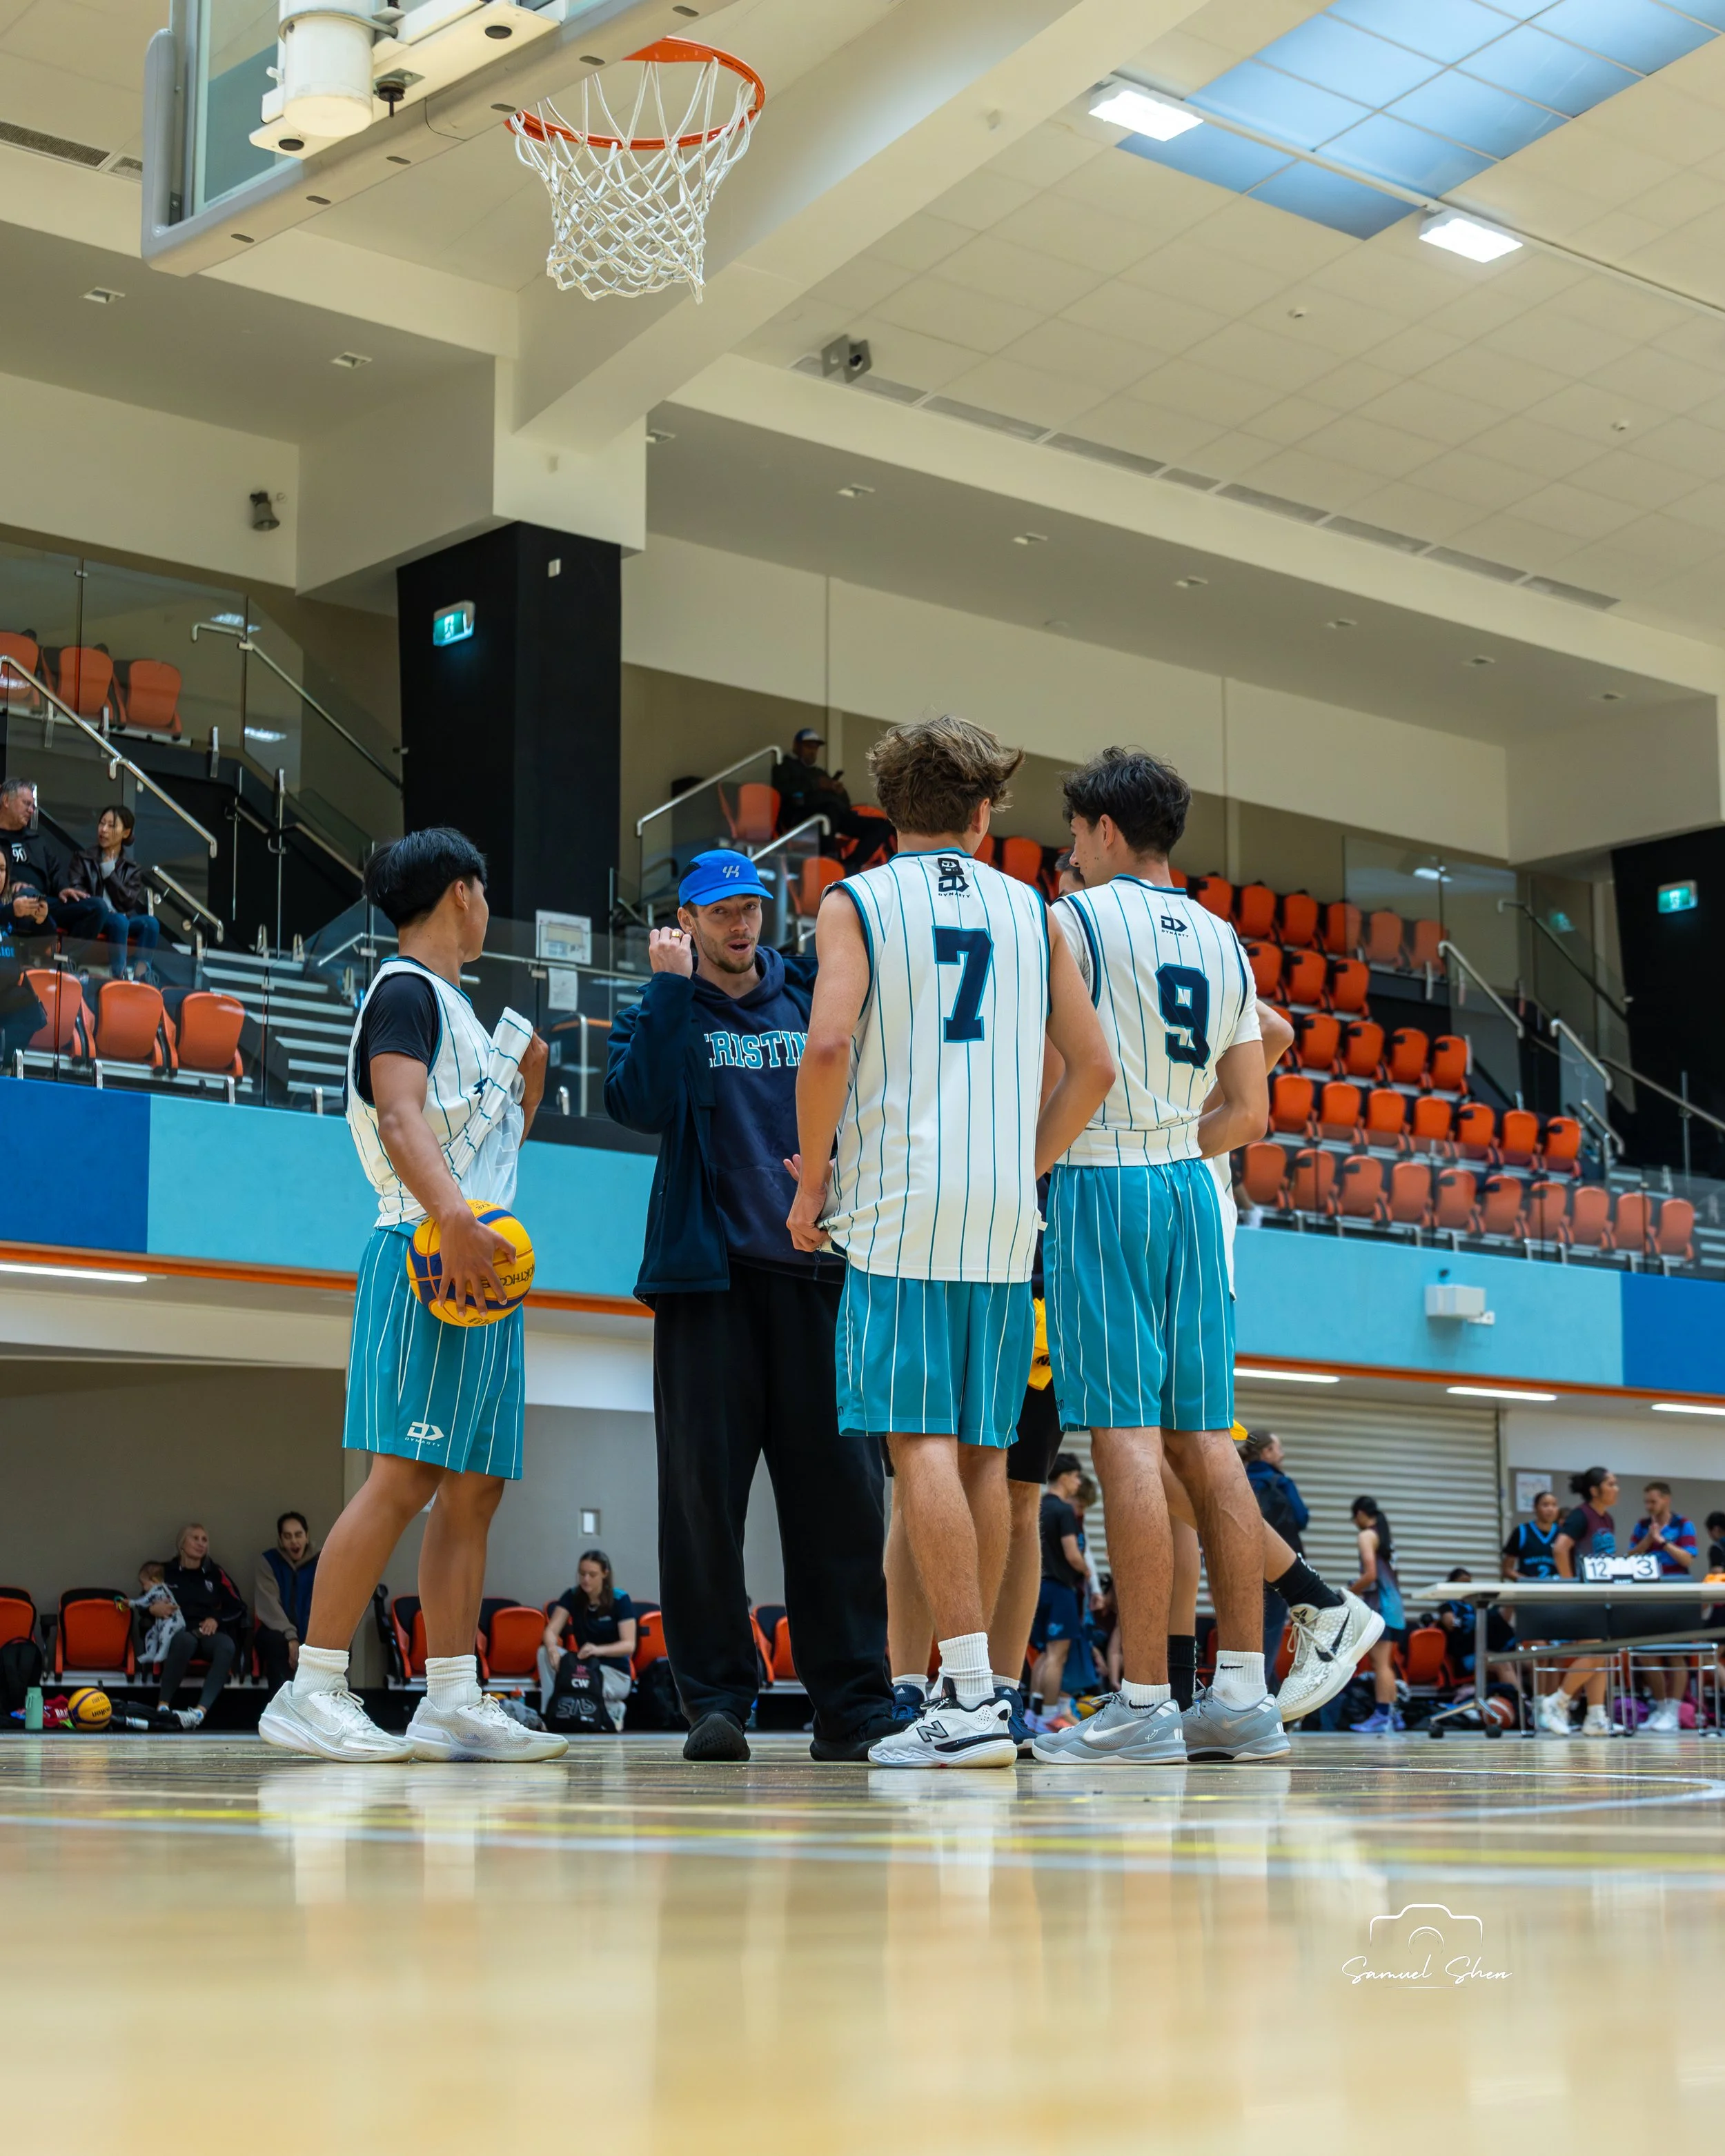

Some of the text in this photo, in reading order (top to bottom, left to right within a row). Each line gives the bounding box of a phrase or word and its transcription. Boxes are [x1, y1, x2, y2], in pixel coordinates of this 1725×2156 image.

[1161, 929, 1189, 938] DYNASTY
[932, 926, 994, 1043] 7
[1155, 962, 1211, 1069] 9
[704, 1030, 808, 1069] RISTI
[404, 1436, 441, 1447] DYNASTY
[1589, 1559, 1653, 1576] 12 3
[571, 1678, 590, 1688] CW
